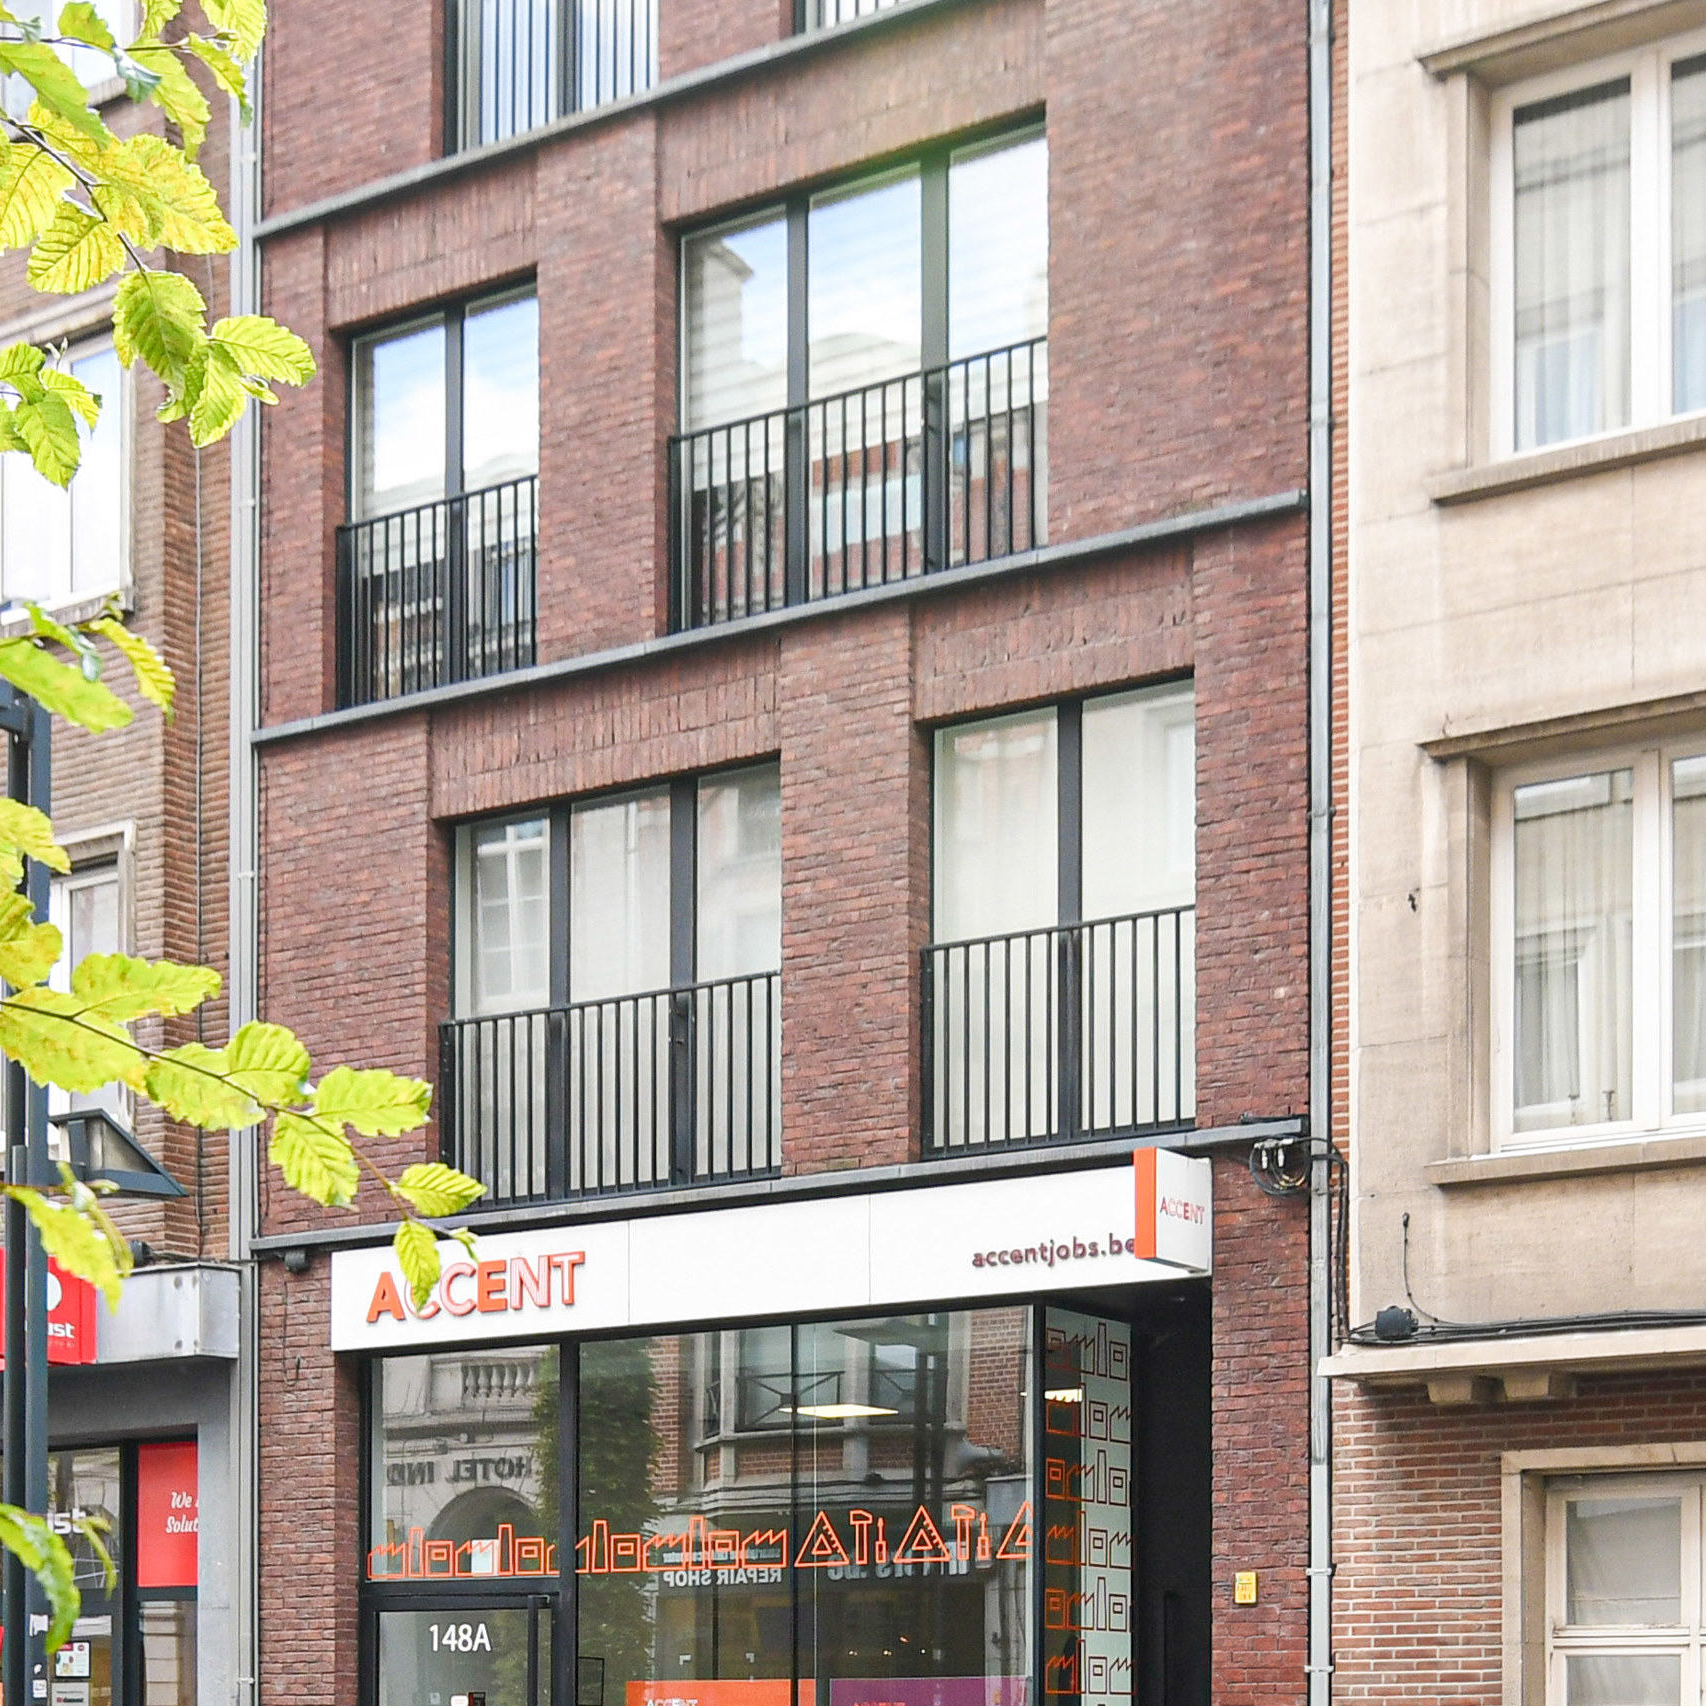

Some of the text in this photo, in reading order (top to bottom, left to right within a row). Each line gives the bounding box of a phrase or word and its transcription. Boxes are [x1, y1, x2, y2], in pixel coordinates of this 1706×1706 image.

[1159, 1196, 1205, 1225] ACCENT
[972, 1232, 1135, 1268] accentjobs.be
[366, 1251, 585, 1324] ACCENT
[171, 1491, 193, 1509] We
[429, 1623, 492, 1652] 148A
